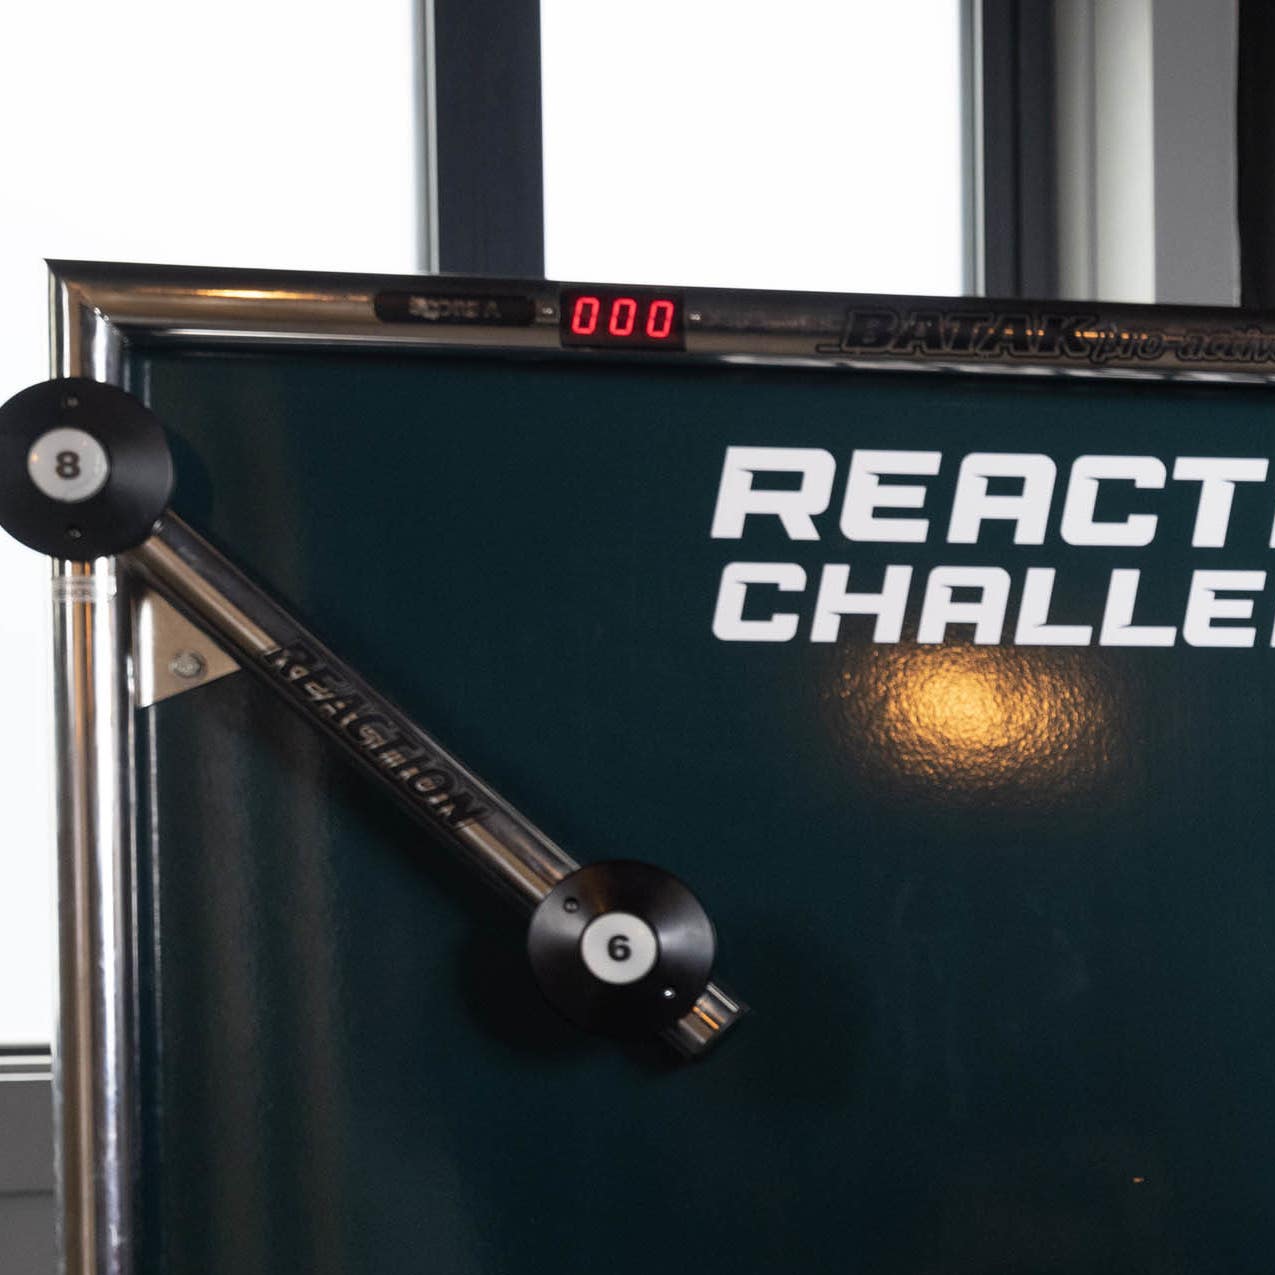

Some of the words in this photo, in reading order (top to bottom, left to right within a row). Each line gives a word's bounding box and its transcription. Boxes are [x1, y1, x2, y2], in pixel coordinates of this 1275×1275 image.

[570, 296, 676, 338] 000
[838, 308, 1092, 359] BATAK
[55, 452, 81, 480] 8
[607, 935, 631, 962] 6
